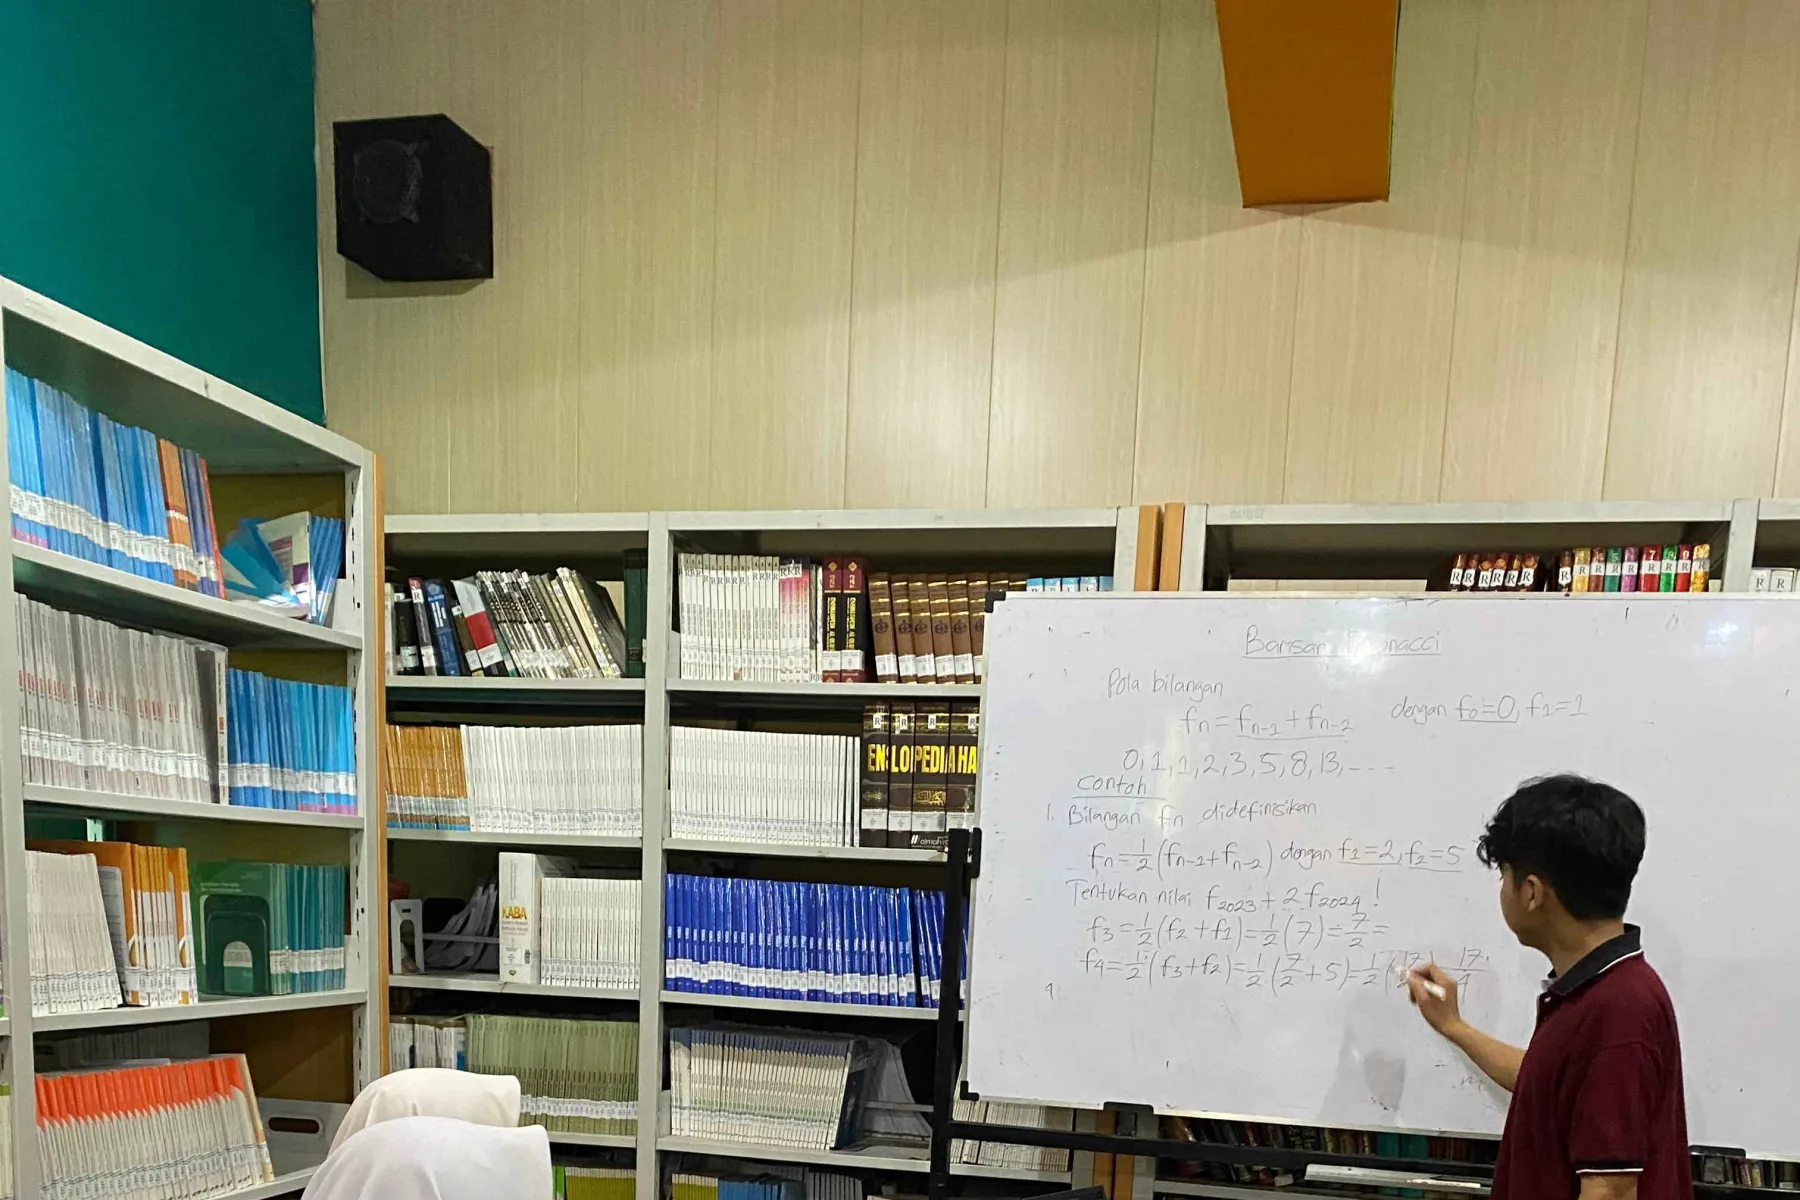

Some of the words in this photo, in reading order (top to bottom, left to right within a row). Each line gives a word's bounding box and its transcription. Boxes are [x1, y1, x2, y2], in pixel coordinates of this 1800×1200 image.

[1153, 672, 1224, 702] bilangan
[1391, 695, 1447, 725] dengan
[1068, 805, 1141, 831] Bilangan
[1065, 879, 1148, 906] Tentukan
[1156, 888, 1192, 906] nilai
